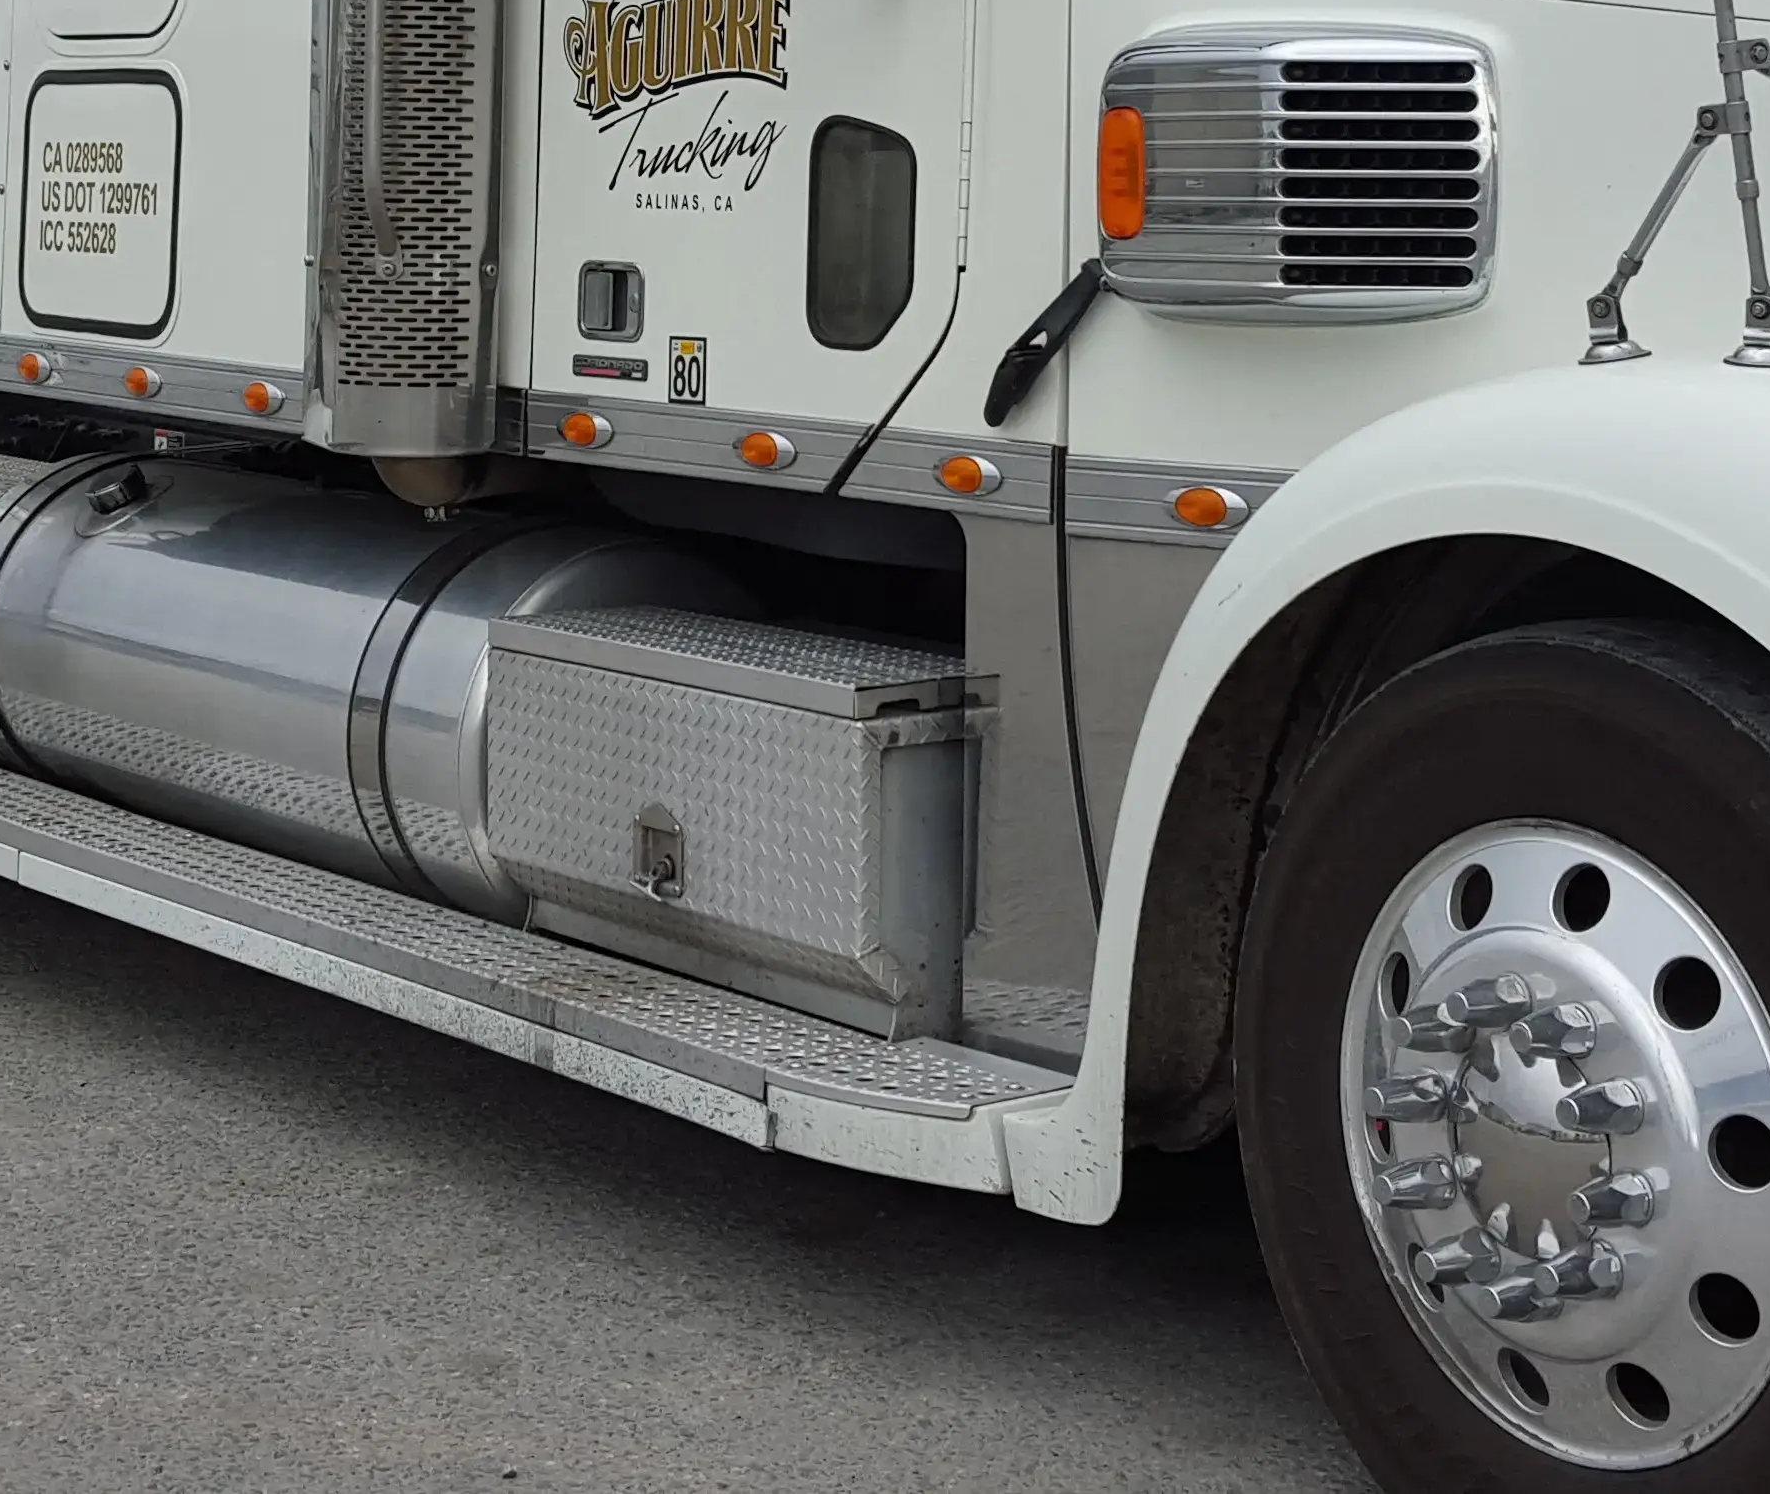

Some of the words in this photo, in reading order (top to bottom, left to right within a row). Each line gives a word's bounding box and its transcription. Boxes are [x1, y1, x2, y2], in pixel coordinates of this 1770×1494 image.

[43, 141, 63, 173] CA
[66, 142, 123, 174] 0289568
[598, 90, 788, 192] Trucking
[41, 180, 61, 212] US
[64, 181, 96, 213] DOT
[99, 182, 158, 216] 1299761
[635, 193, 705, 213] SALINAS,
[714, 195, 734, 212] CA
[39, 219, 64, 252] ICC
[67, 221, 117, 254] 552628
[673, 354, 701, 398] 80
